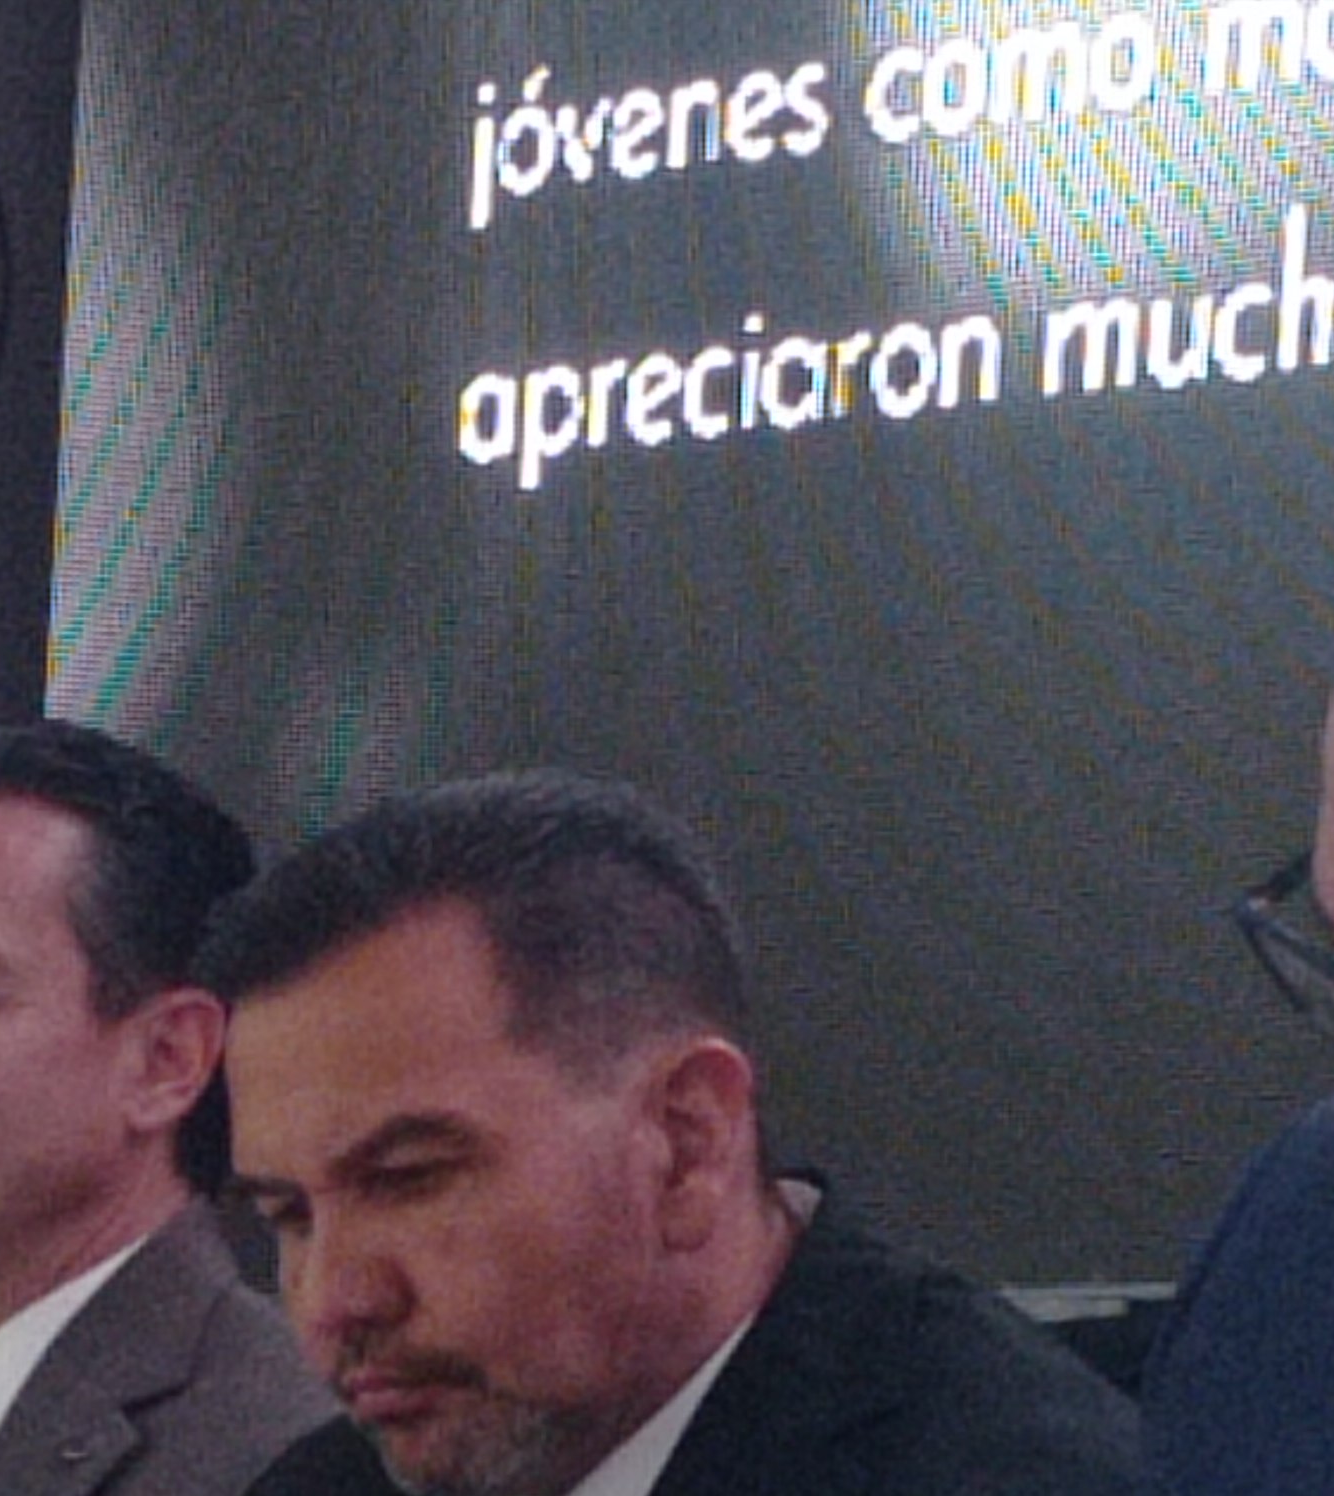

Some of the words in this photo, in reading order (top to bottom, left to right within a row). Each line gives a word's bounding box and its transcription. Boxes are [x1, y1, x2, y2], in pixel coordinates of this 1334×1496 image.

[469, 62, 829, 229] jóvenes
[865, 14, 1155, 144] como
[459, 314, 1001, 490] apreciaron
